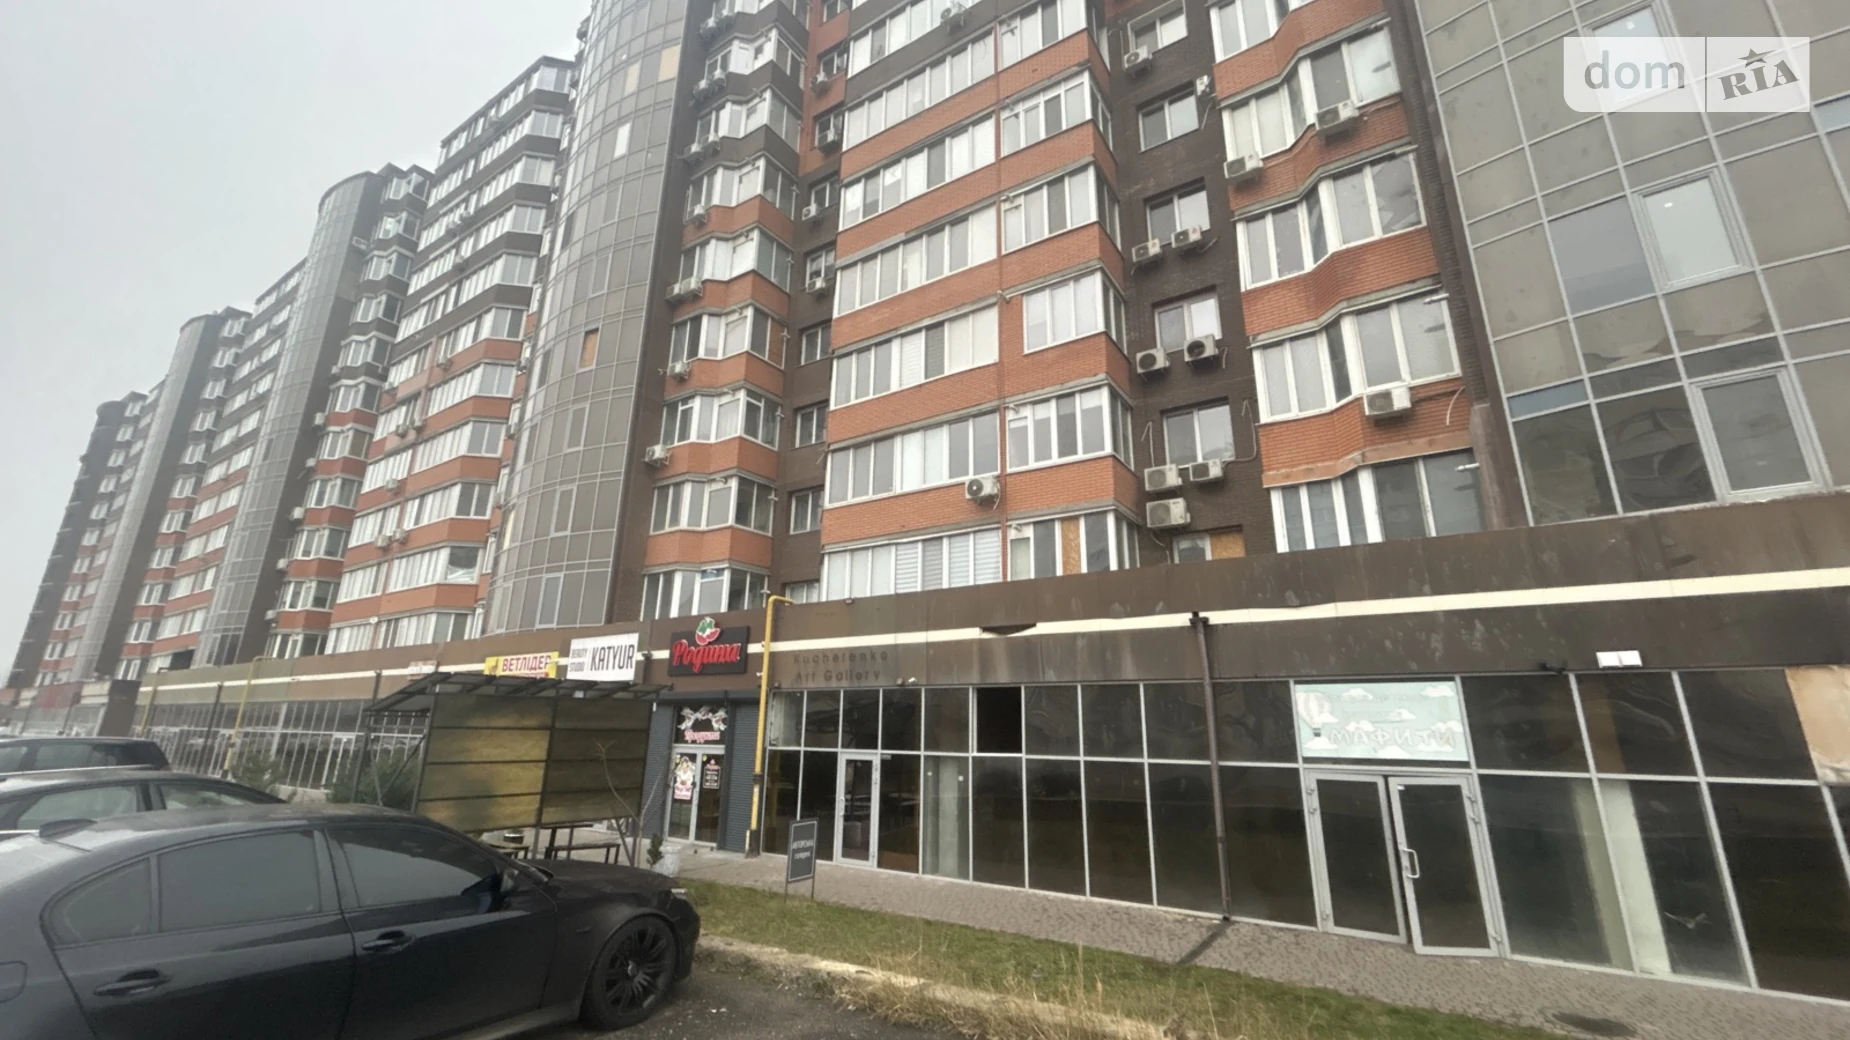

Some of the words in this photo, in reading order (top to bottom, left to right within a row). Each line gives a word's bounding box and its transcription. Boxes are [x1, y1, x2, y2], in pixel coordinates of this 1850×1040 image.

[590, 644, 635, 671] KATYUR
[672, 639, 742, 673] Родина
[793, 650, 888, 665] Kucherenko
[824, 669, 881, 682] Gallery
